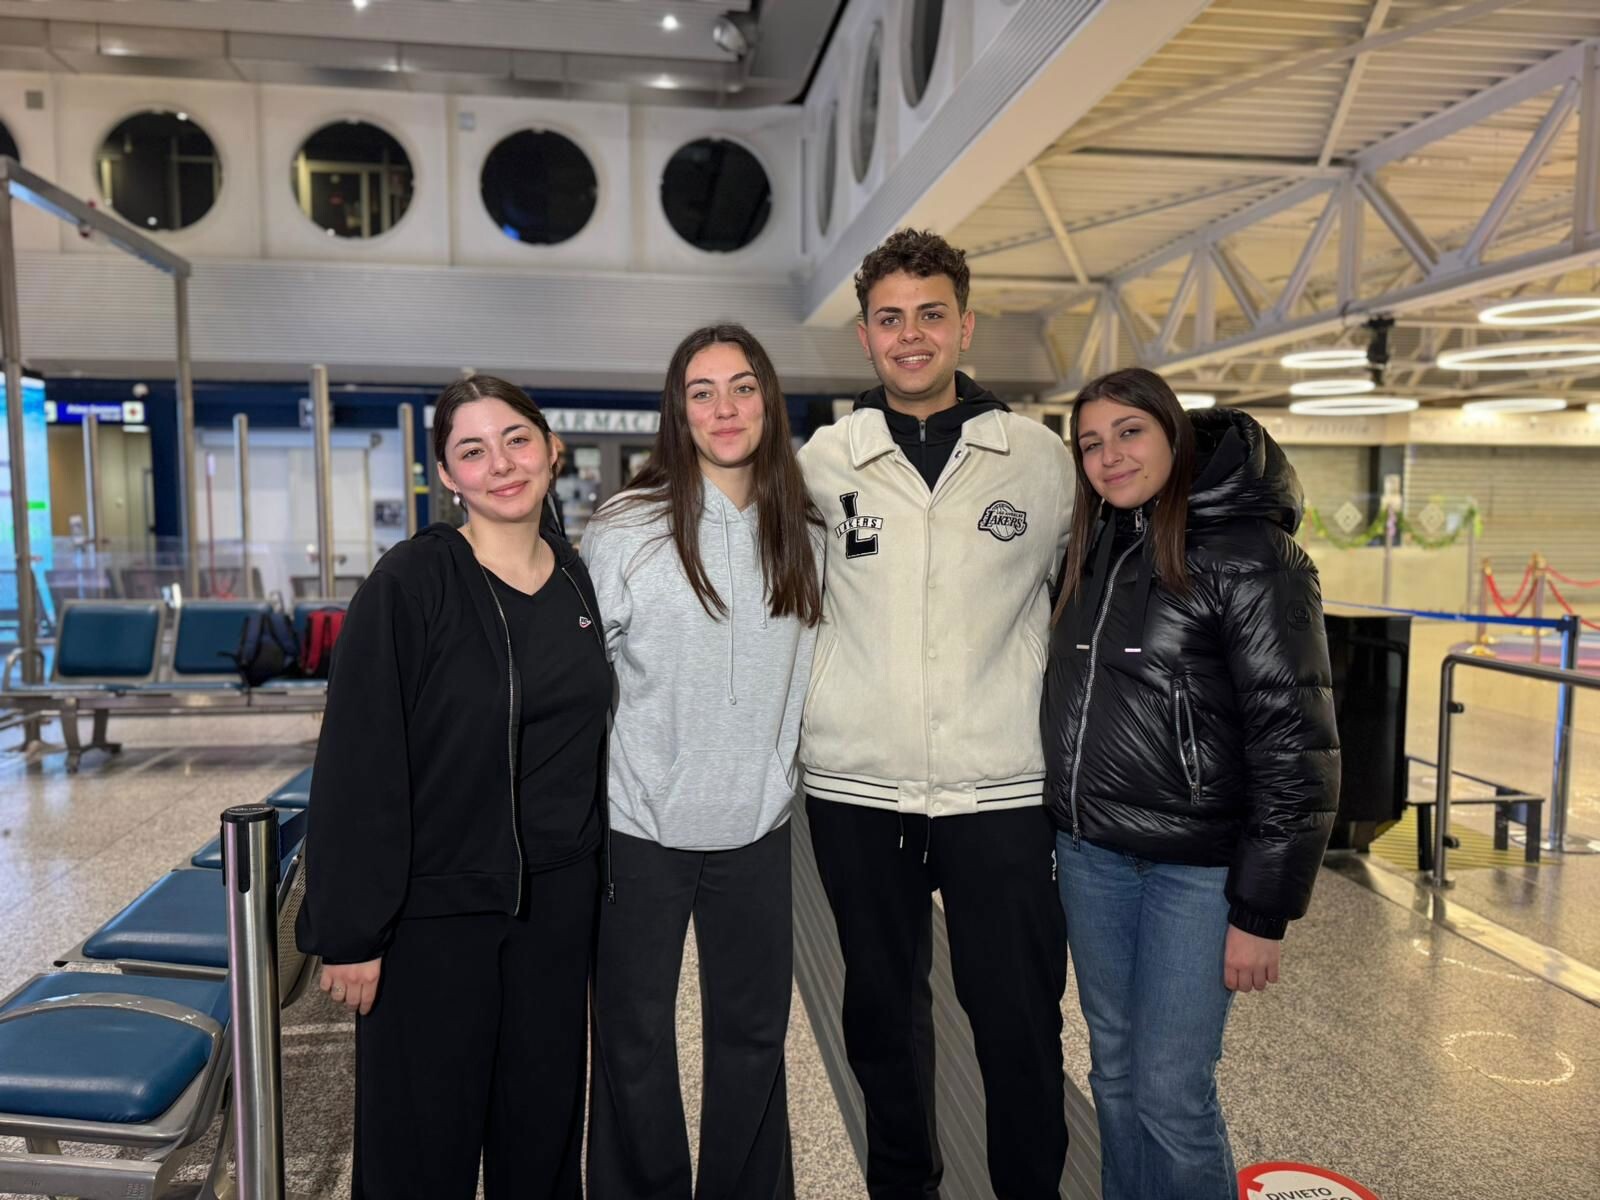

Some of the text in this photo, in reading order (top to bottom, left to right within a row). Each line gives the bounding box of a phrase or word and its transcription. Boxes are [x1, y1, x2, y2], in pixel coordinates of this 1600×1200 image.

[541, 411, 660, 432] ARMACI
[837, 517, 878, 536] LAKERS
[983, 510, 1024, 531] LAKERS
[1265, 1187, 1332, 1200] DIVIETO
